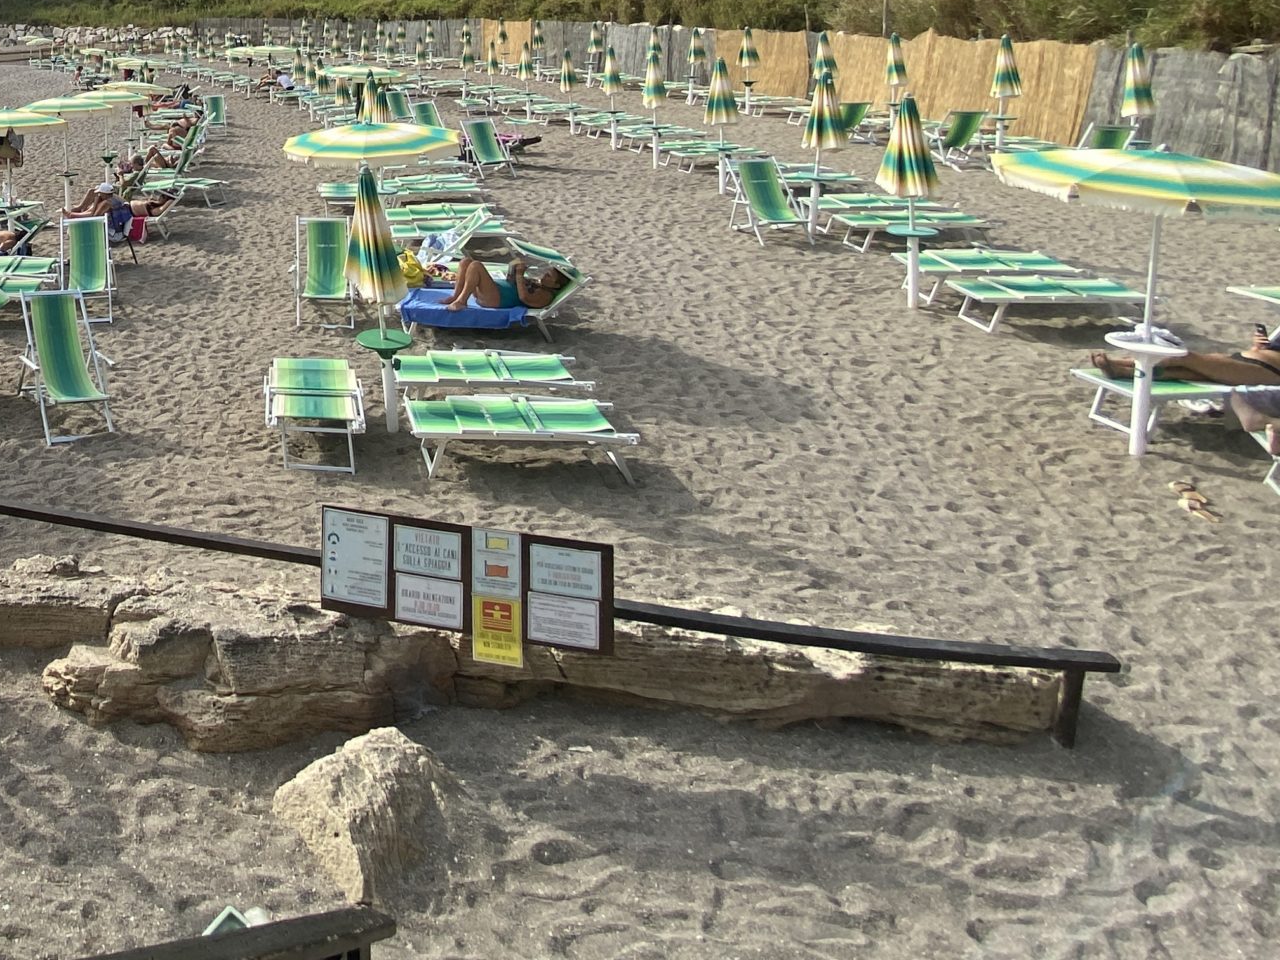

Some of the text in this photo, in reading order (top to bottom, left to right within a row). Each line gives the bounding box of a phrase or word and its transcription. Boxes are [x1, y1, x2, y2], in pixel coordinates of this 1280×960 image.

[415, 531, 440, 545] VIETATO
[434, 547, 440, 557] AI
[443, 548, 457, 559] CANI
[402, 554, 451, 570] SULLA SPIAGGIA
